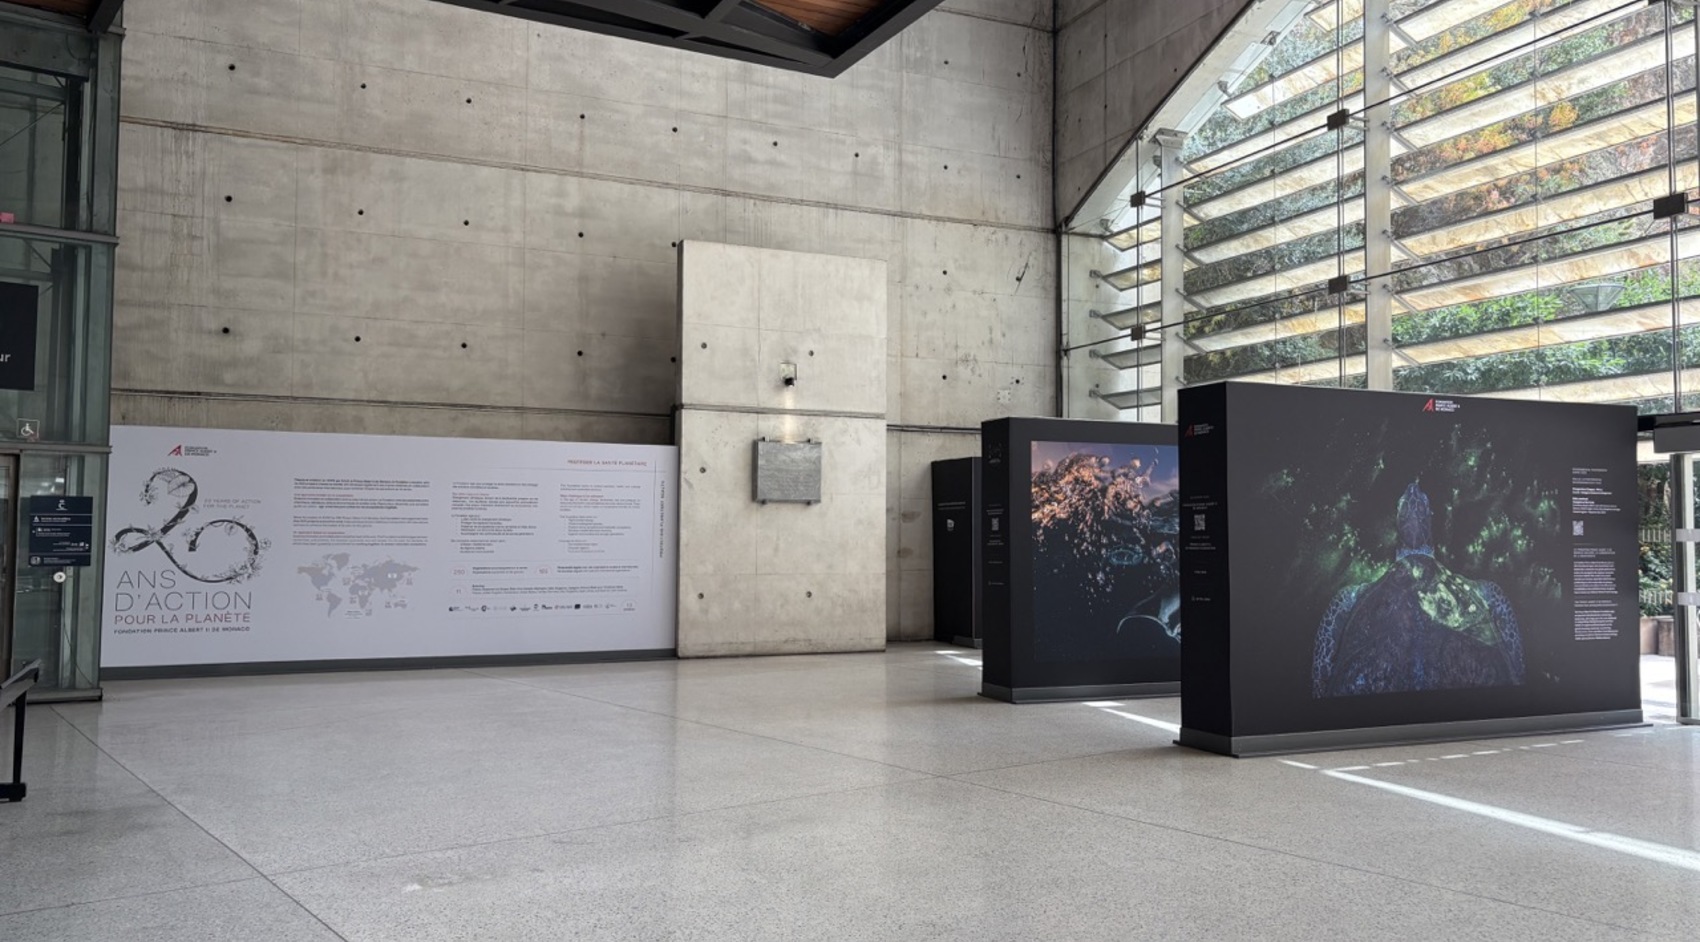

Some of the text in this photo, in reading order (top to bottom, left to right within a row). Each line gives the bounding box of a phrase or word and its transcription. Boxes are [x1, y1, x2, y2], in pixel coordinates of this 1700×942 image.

[116, 569, 176, 589] ANS
[115, 591, 252, 611] D'ACTION
[114, 611, 250, 625] POUR LA PLANÈTE
